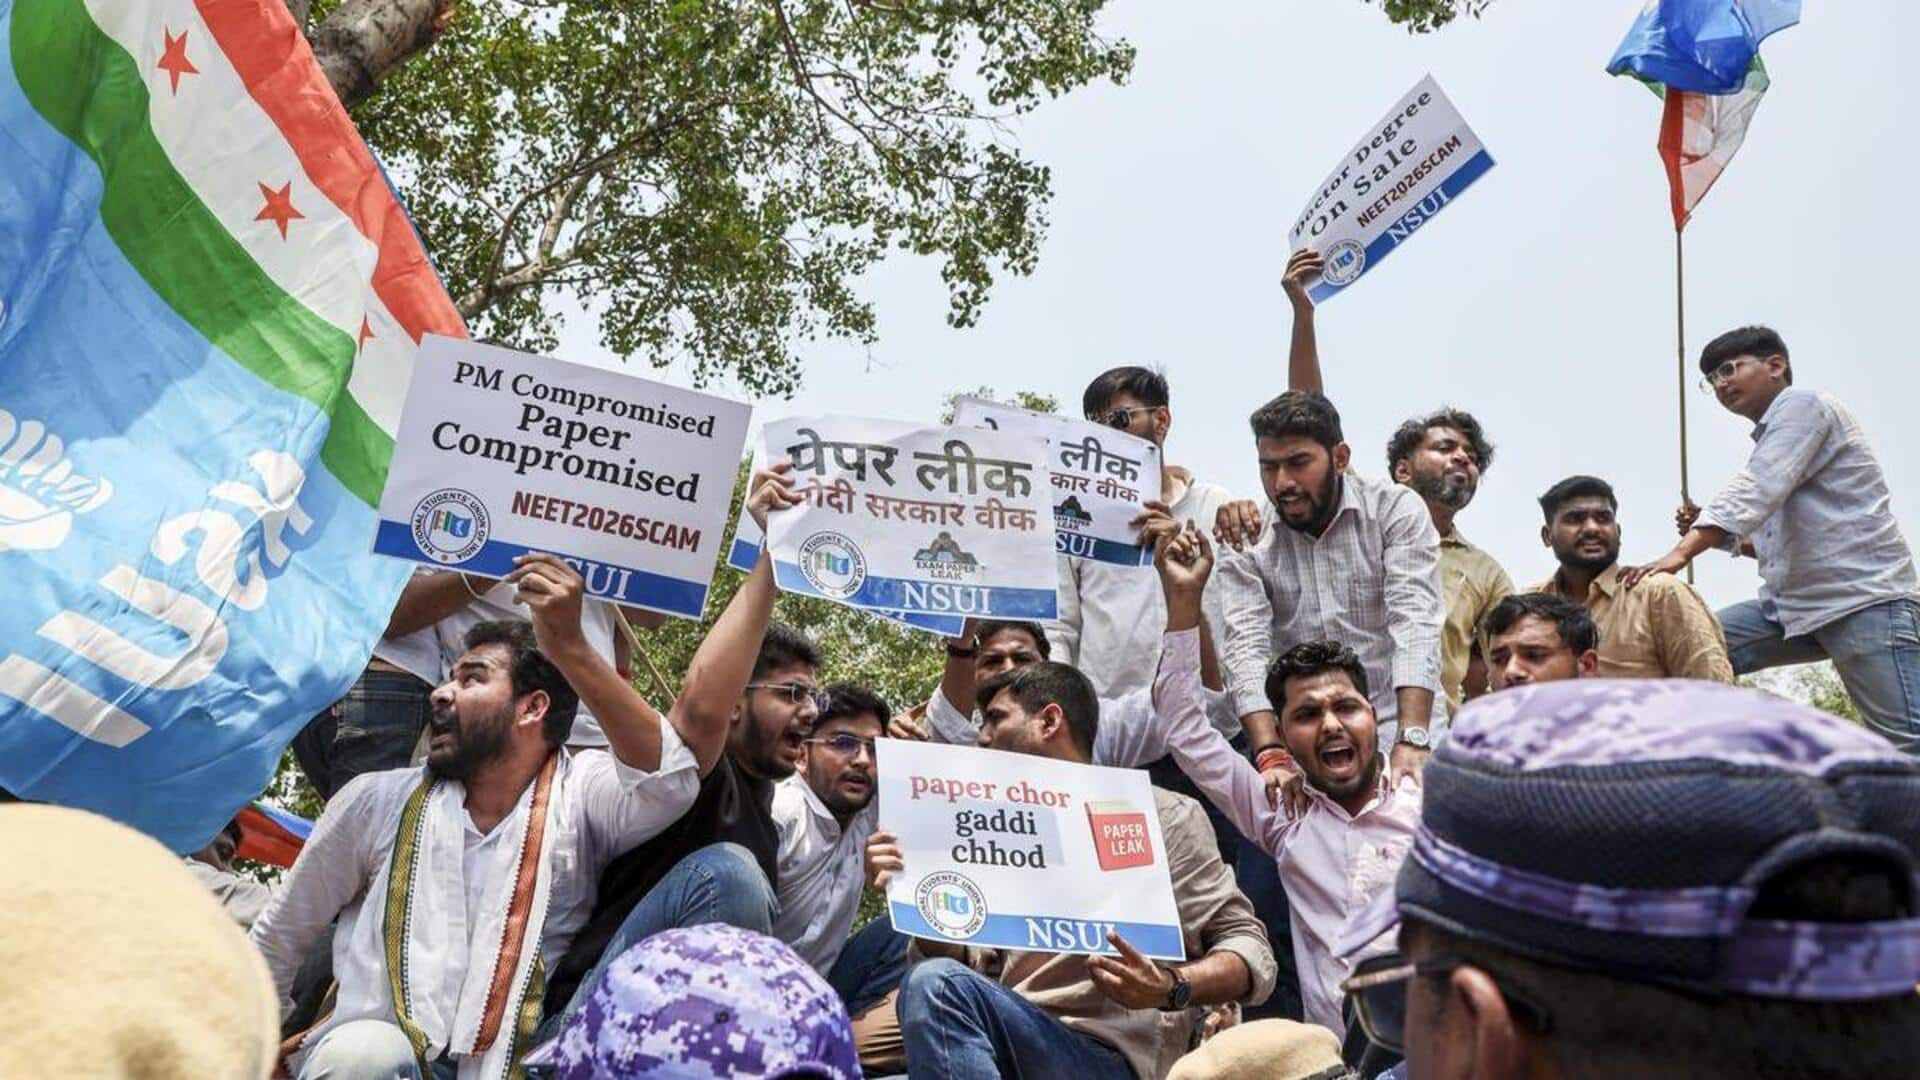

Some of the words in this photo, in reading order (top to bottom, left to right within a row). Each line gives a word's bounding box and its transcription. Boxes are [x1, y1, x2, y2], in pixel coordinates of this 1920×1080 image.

[1295, 166, 1350, 236] Doctor
[1354, 90, 1432, 164] Degree
[1357, 134, 1462, 228] NEET2026SCAM
[1310, 199, 1348, 237] On
[1353, 137, 1418, 197] Sale
[1387, 187, 1451, 244] NSUI
[452, 361, 504, 391] PM
[511, 373, 716, 438] Compromised
[516, 402, 631, 451] Paper
[431, 421, 701, 502] Compromised
[786, 428, 898, 487] पेपर
[913, 439, 1032, 498] लीक
[1060, 436, 1142, 482] लीक
[866, 492, 966, 529] सरकार
[974, 497, 1036, 532] वीक
[1096, 477, 1140, 502] वीक
[511, 490, 701, 552] NEET2026SCAM
[1055, 531, 1097, 558] SUI
[901, 581, 992, 615] NSUI
[909, 774, 997, 805] paper
[1006, 781, 1071, 809] chor
[955, 810, 1037, 838] gaddi
[1103, 823, 1145, 840] PAPER
[951, 839, 1047, 869] chhod
[1111, 840, 1145, 856] LEAK
